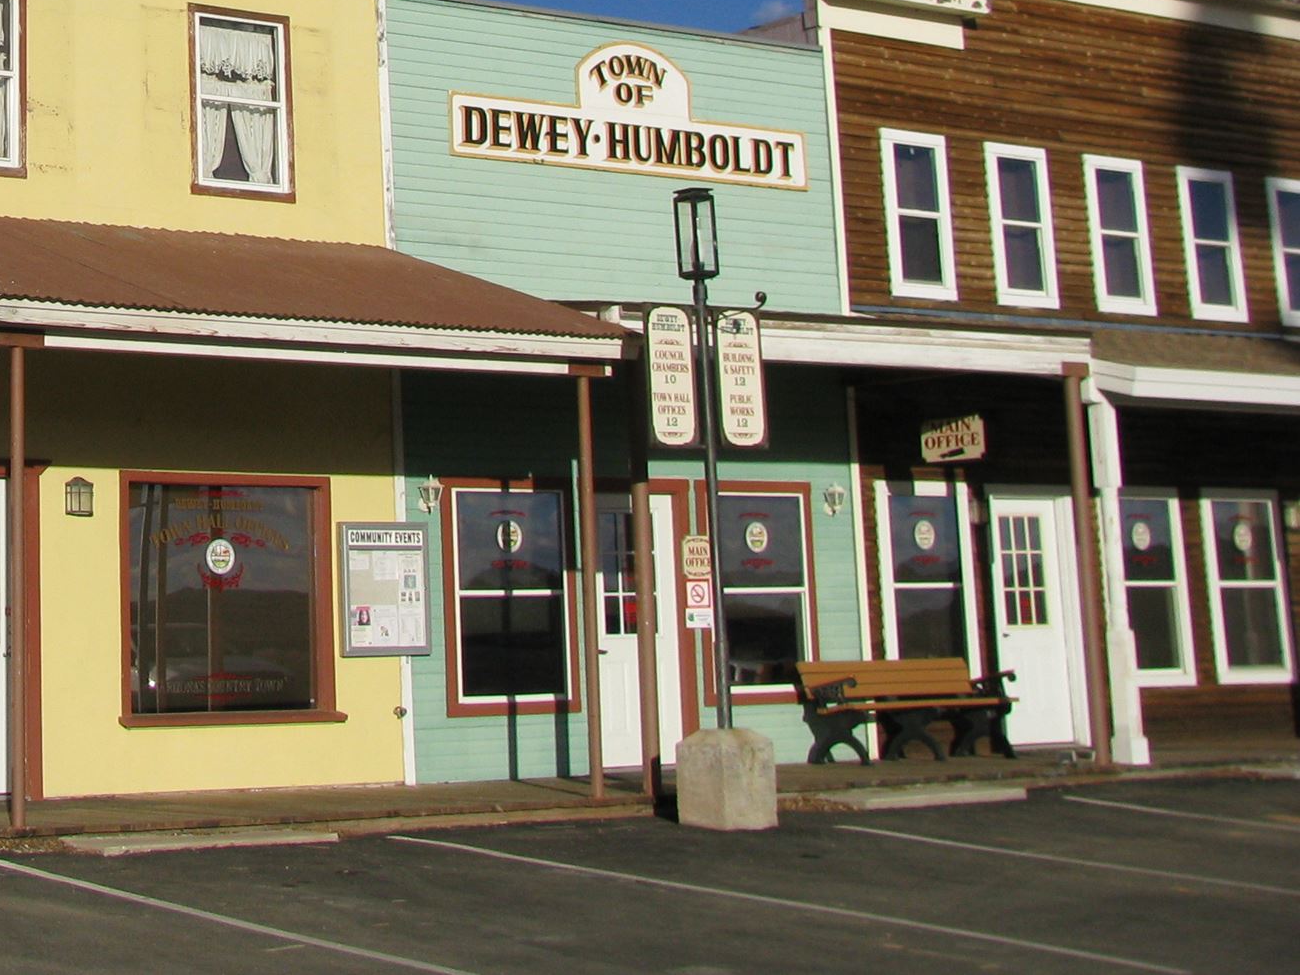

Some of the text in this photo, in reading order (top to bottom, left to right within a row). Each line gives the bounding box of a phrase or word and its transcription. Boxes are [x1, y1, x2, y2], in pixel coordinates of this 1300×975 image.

[588, 53, 668, 91] TOWN
[614, 82, 655, 108] OF
[654, 350, 685, 361] COUNCIL
[723, 353, 755, 363] BUILDING
[652, 362, 689, 373] CHAMBERS
[730, 366, 755, 375] SAFETY
[664, 374, 677, 385] 10
[734, 376, 746, 386] 12
[653, 392, 691, 403] TOWN HALL
[730, 394, 753, 404] PUBLIC
[657, 405, 687, 415] OFFICES
[730, 406, 755, 416] WORKS
[666, 416, 679, 427] 12
[736, 418, 749, 428] 12
[924, 432, 981, 450] OFFICE
[350, 531, 421, 544] COMMUNITY EVENTS
[688, 546, 708, 556] MAIN
